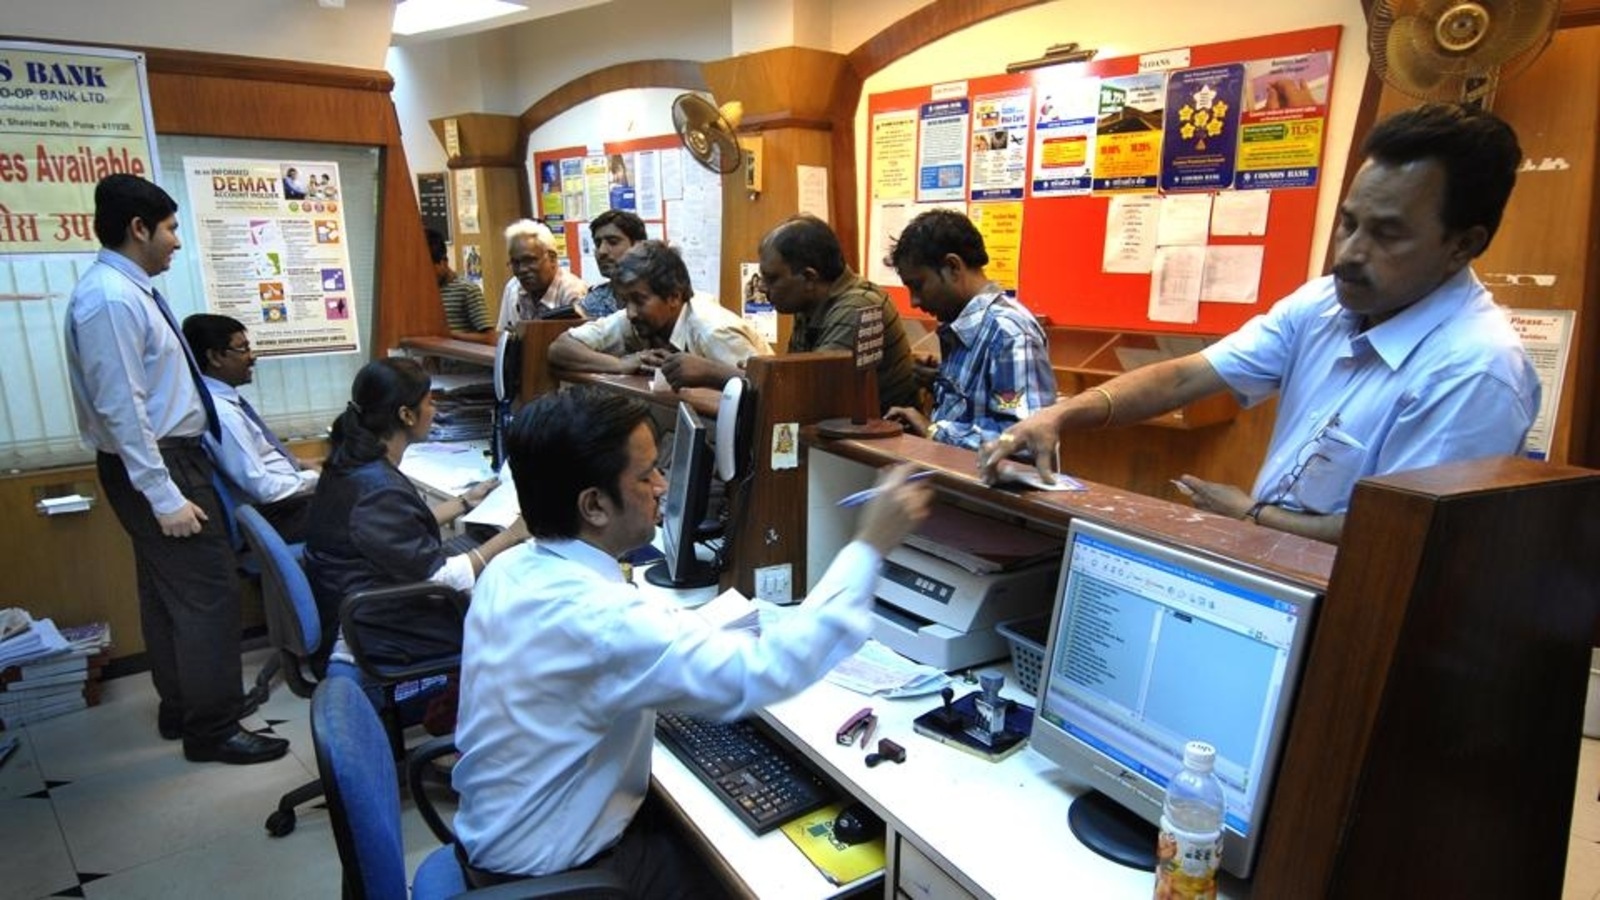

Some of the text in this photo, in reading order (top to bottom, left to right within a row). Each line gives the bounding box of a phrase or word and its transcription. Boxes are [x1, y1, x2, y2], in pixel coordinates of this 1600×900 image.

[25, 61, 107, 88] BANK
[40, 89, 77, 102] BANK
[37, 144, 145, 183] Available
[1287, 169, 1310, 178] BANK
[213, 177, 277, 192] DEMAT
